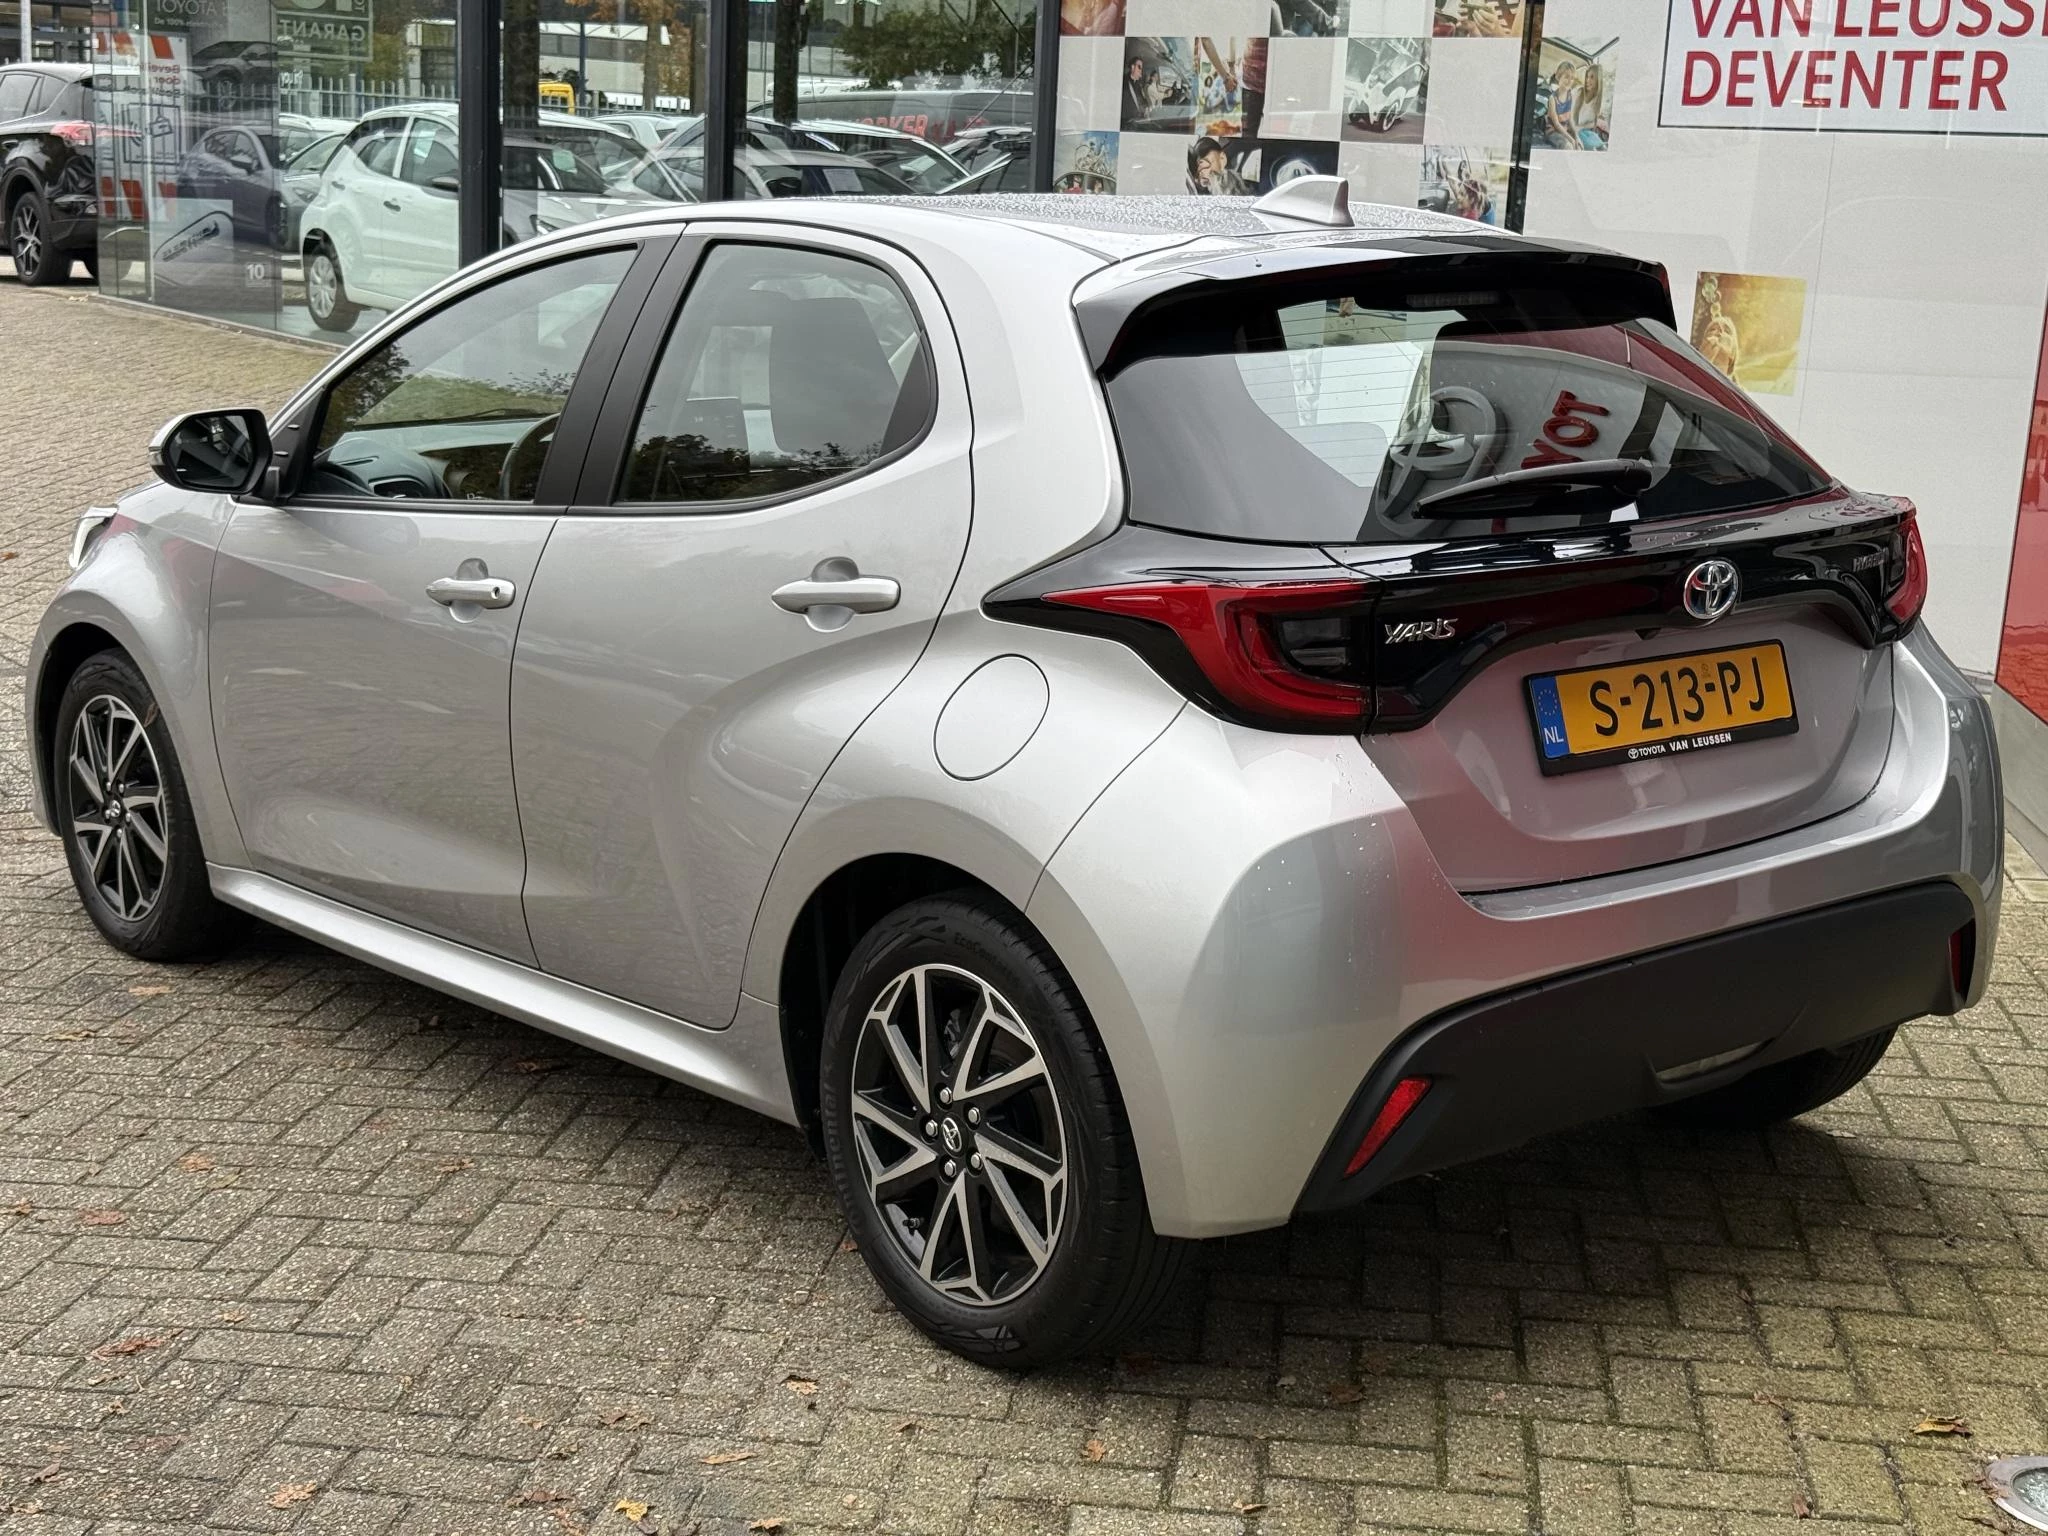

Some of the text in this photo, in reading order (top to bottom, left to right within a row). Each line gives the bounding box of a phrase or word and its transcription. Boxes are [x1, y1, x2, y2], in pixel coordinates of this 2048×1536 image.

[1692, 0, 2048, 38] VAN LEUSS
[1682, 51, 2009, 111] DEVENTER
[247, 264, 265, 280] 10
[1384, 618, 1459, 644] YARIS
[1589, 656, 1766, 737] S-213-PJ
[1544, 726, 1564, 745] NL
[1638, 732, 1732, 757] TOYOTA VAN LEUSSEN
